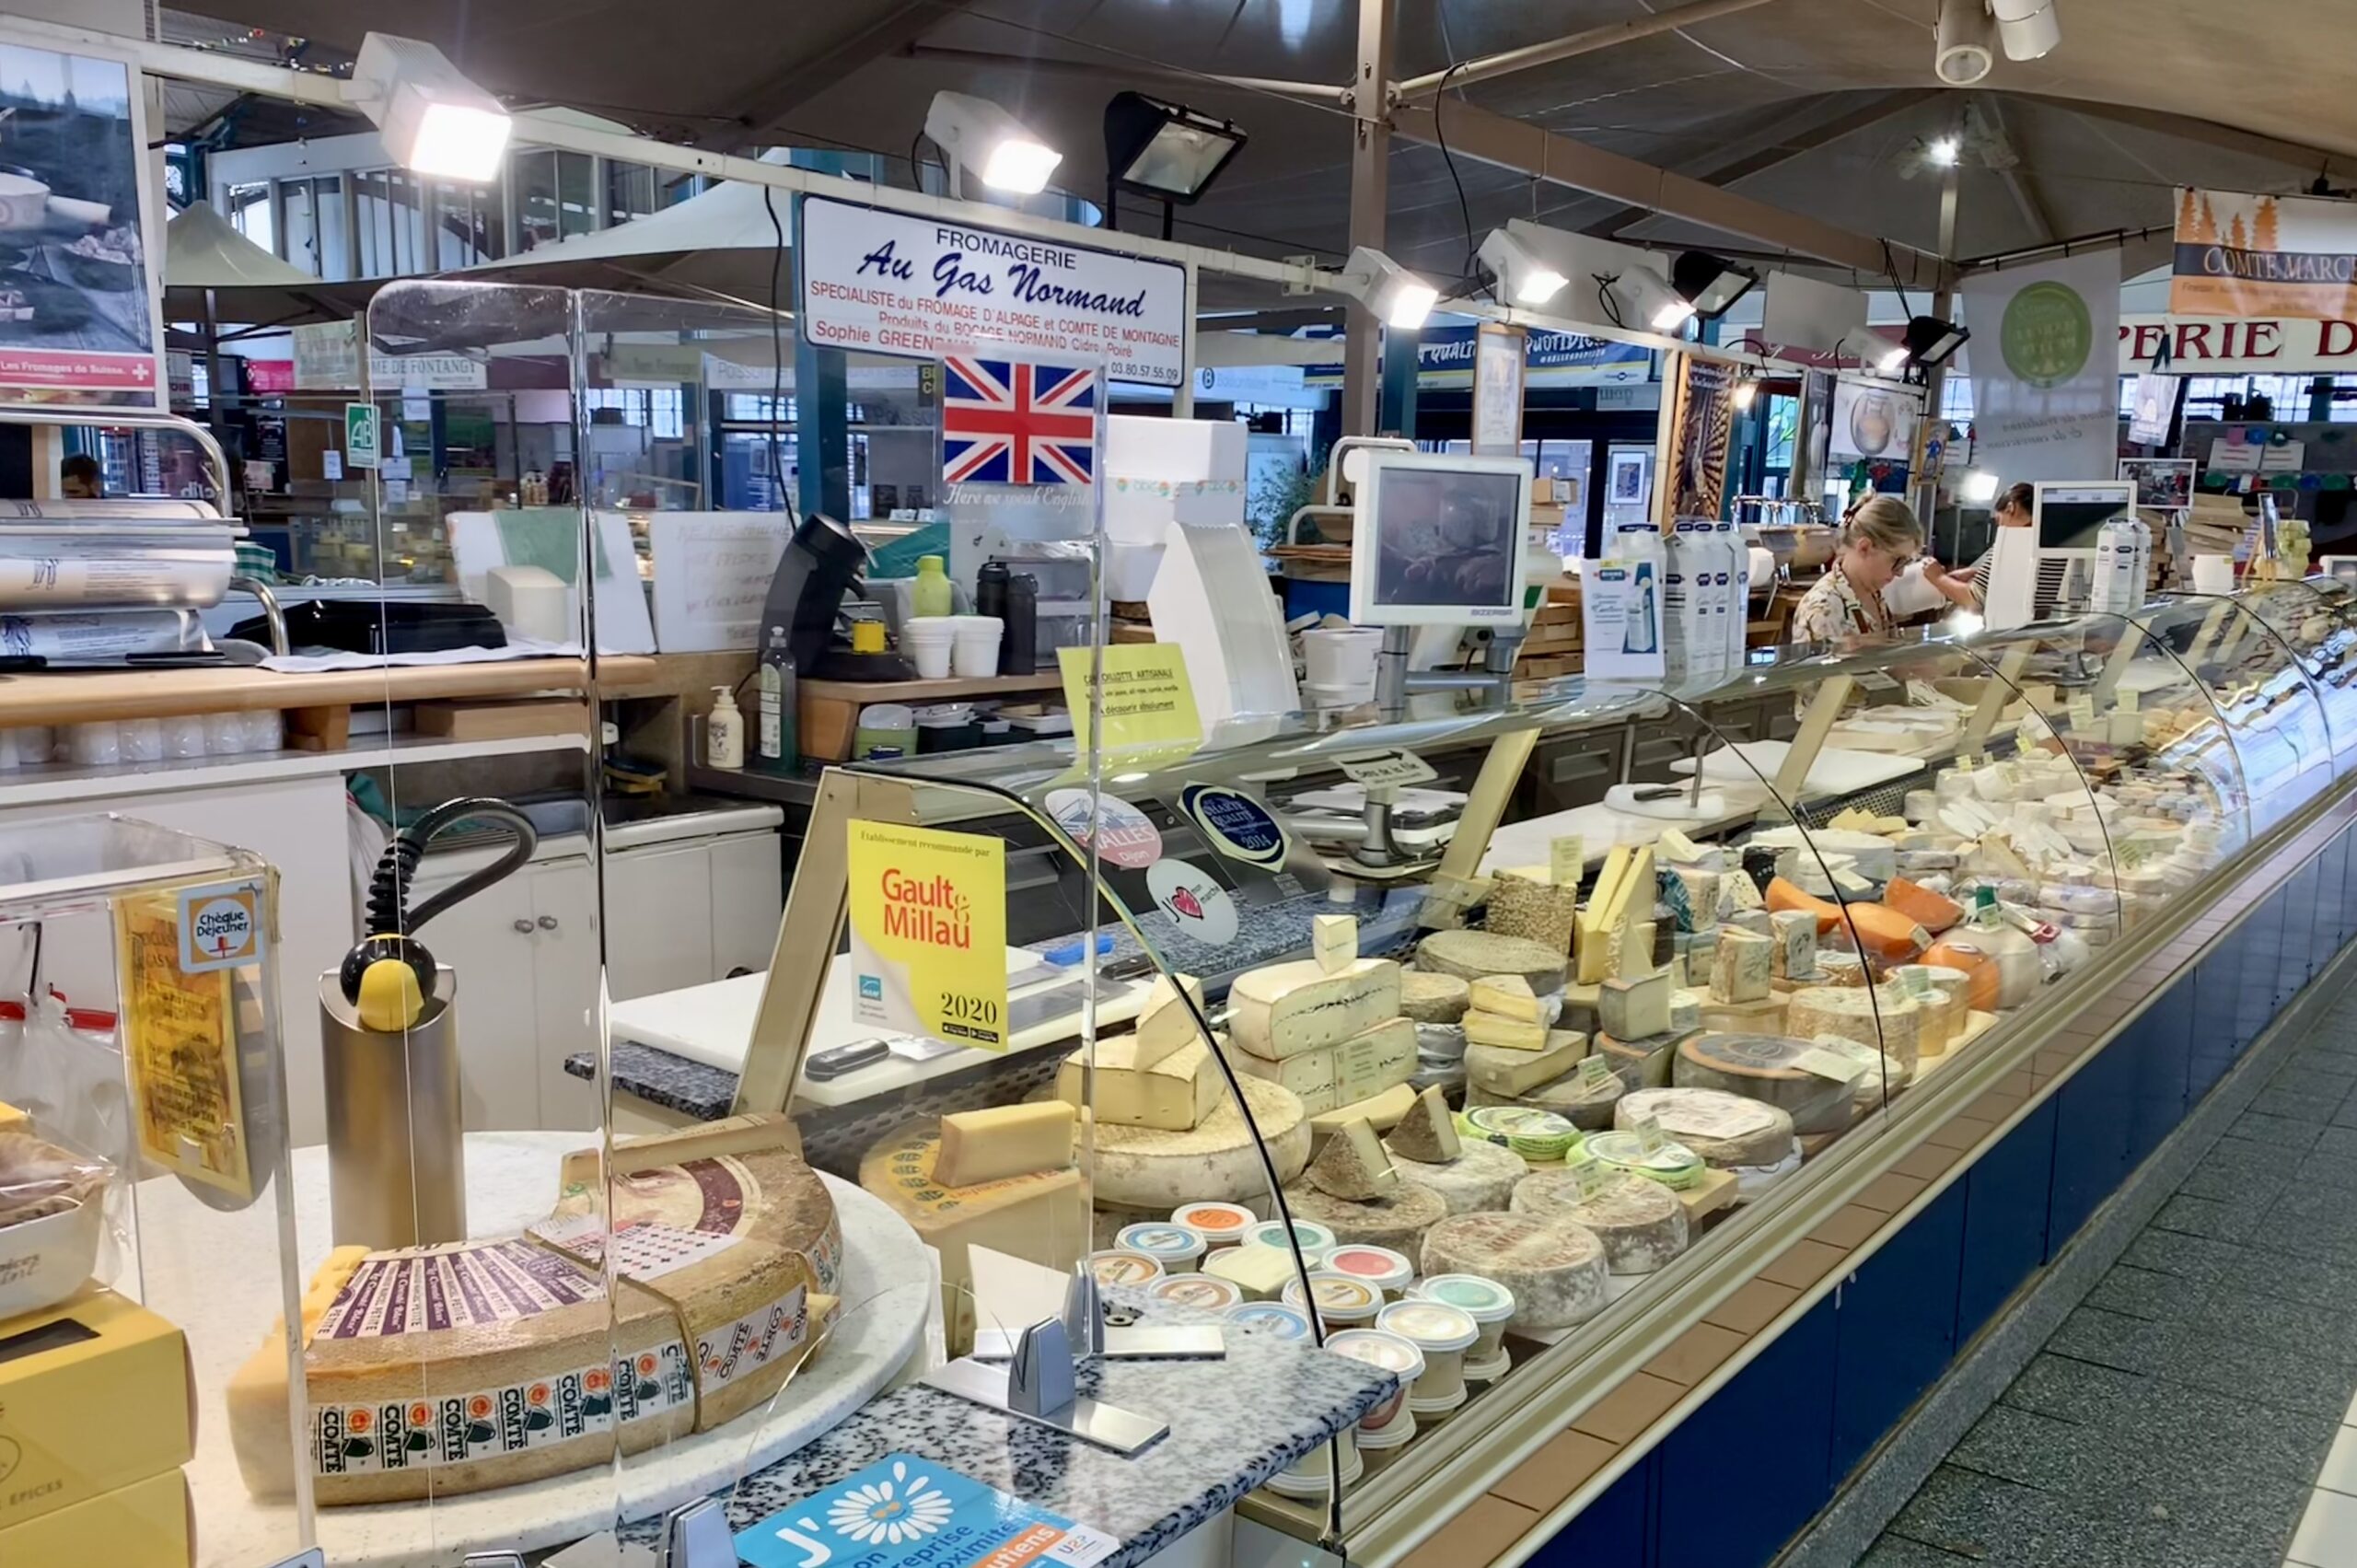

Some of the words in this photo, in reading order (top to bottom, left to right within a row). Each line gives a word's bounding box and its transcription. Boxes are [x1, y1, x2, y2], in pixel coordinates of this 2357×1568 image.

[936, 228, 1076, 270] FROMAGERIE
[856, 240, 913, 280] Au
[933, 252, 993, 297] Gas
[1007, 263, 1145, 318] Normand
[810, 281, 895, 308] SPECIALISTE
[898, 296, 913, 309] du
[917, 298, 977, 320] FROMAGE
[983, 308, 1040, 330] D'ALPAGE
[1044, 319, 1054, 331] et
[1059, 319, 1098, 337] COMTE
[1103, 325, 1118, 340] DE
[1122, 329, 1179, 348] MONTAGNE
[816, 320, 870, 343] Sophie
[878, 311, 929, 331] Produits
[935, 321, 949, 335] du
[954, 323, 1003, 341] BOCAGE
[1009, 329, 1067, 350] NORMAND
[22, 361, 73, 374] Fromages
[1111, 361, 1178, 381] 03.80.57.55.09
[943, 483, 982, 505] Here
[974, 848, 990, 858] par
[1120, 849, 1150, 863] Dijon
[882, 868, 954, 910] Gault
[199, 911, 245, 930] Chèque
[884, 904, 970, 949] Millau
[941, 992, 997, 1025] 2020
[487, 1291, 508, 1313] PETITE
[526, 1283, 553, 1305] PETITE
[366, 1307, 384, 1331] PETITE
[411, 1303, 423, 1327] PETITE
[450, 1297, 468, 1321] PETITE
